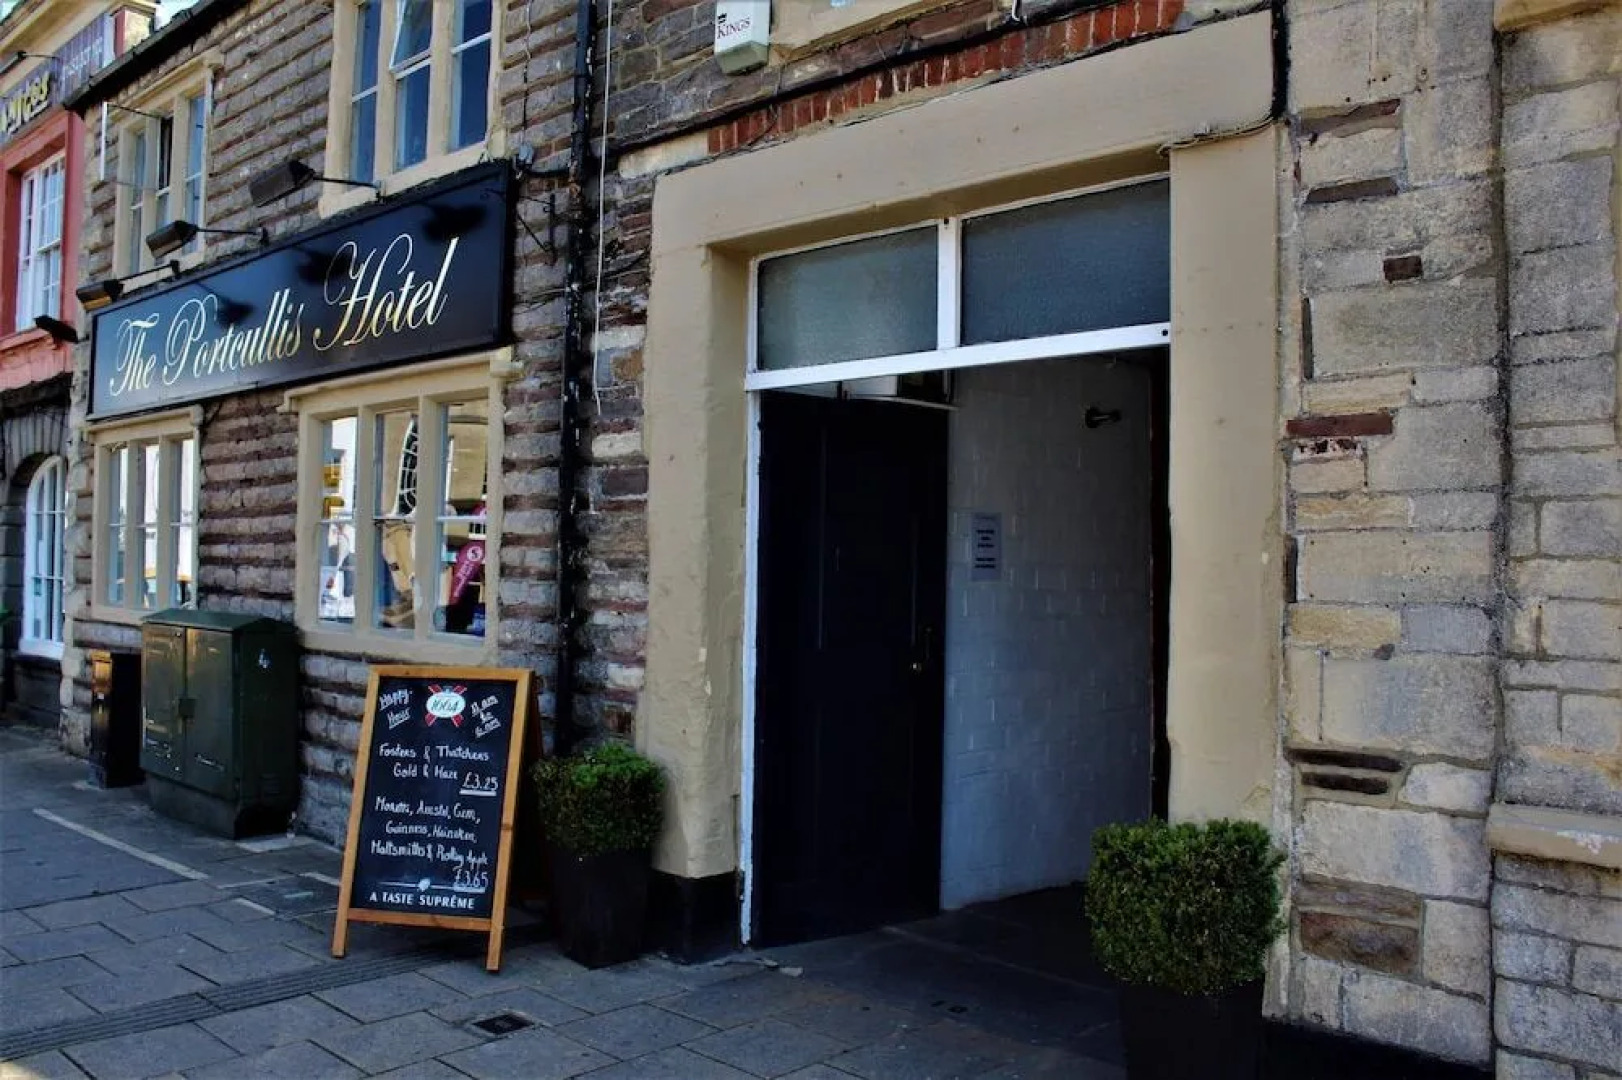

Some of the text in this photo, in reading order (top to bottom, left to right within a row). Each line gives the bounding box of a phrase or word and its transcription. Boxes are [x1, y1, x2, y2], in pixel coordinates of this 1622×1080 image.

[110, 233, 459, 396] The Portcullis Hotel
[393, 762, 418, 778] Gold
[462, 771, 499, 791] £3.25
[369, 891, 378, 902] A
[382, 891, 414, 905] TASTE
